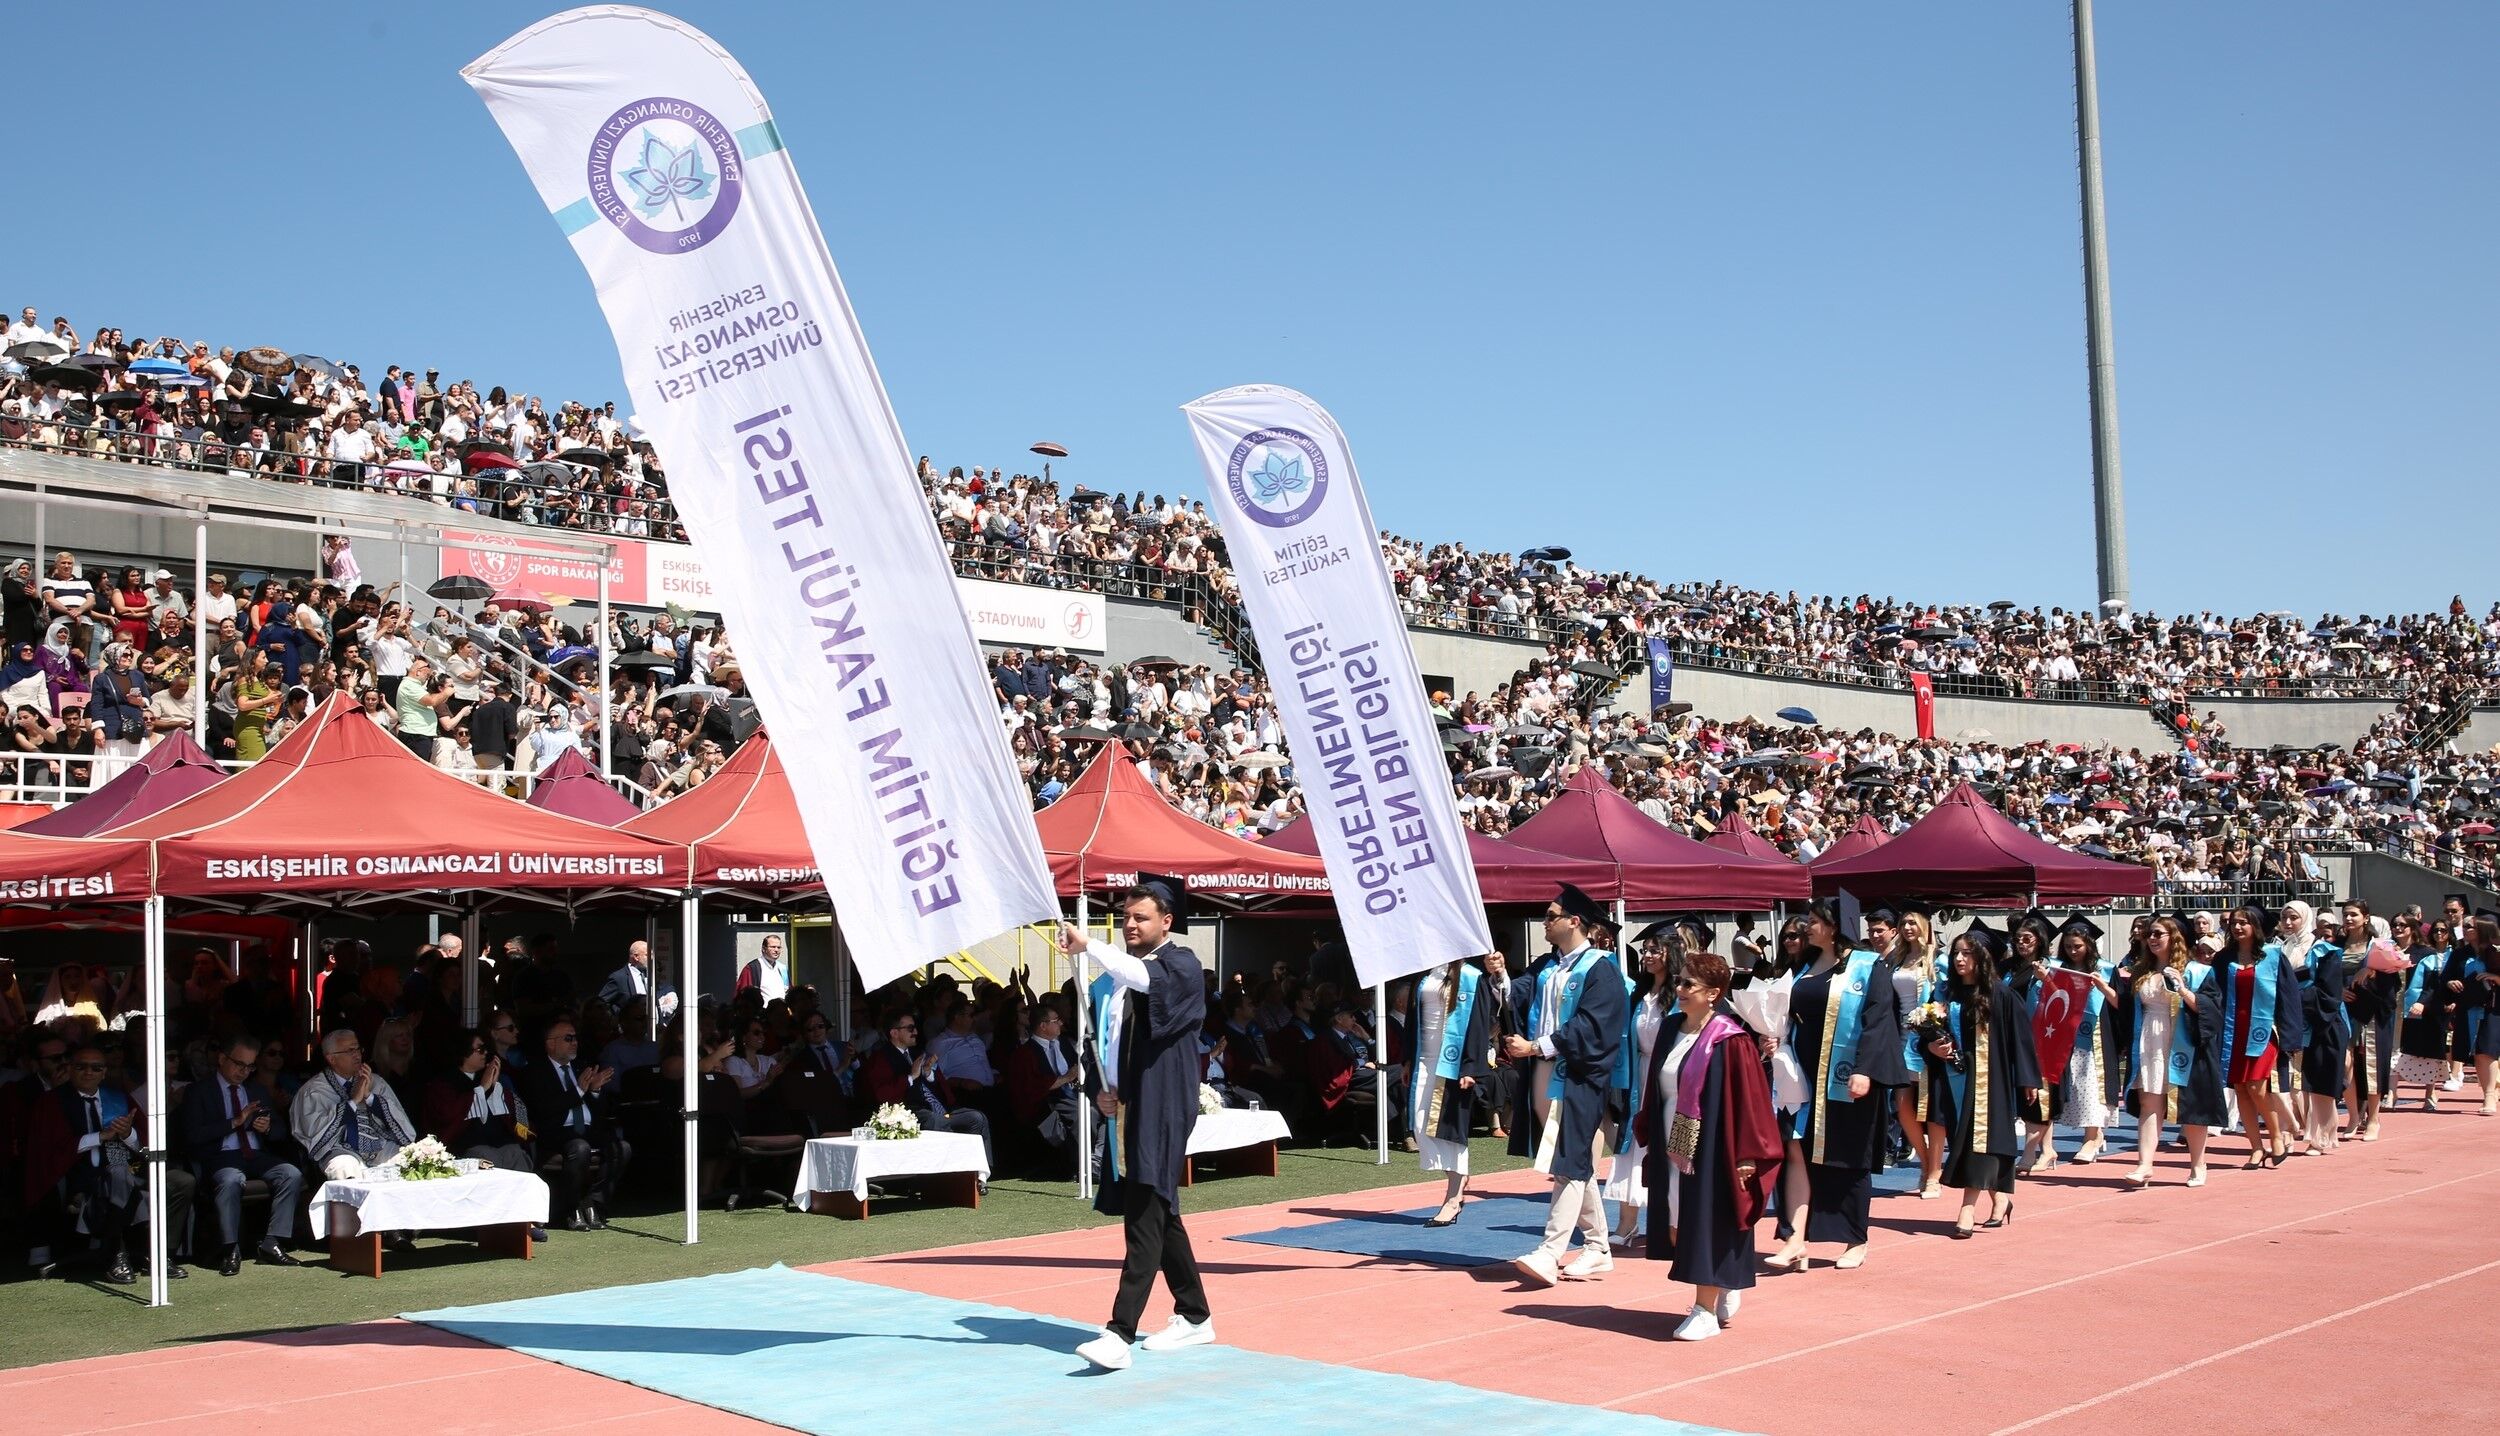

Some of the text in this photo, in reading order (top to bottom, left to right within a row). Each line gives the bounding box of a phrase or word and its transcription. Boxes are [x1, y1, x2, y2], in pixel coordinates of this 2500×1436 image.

[527, 563, 624, 584] SPOR BAKANIĞI
[978, 611, 1046, 630] STADYUMU
[206, 850, 664, 882] ESKİŞEHİR OSMANGAZİ ÜNİVERSİTESİ
[1187, 871, 1269, 889] OSMANGAZİ
[1273, 872, 1332, 890] ÜNİVERS
